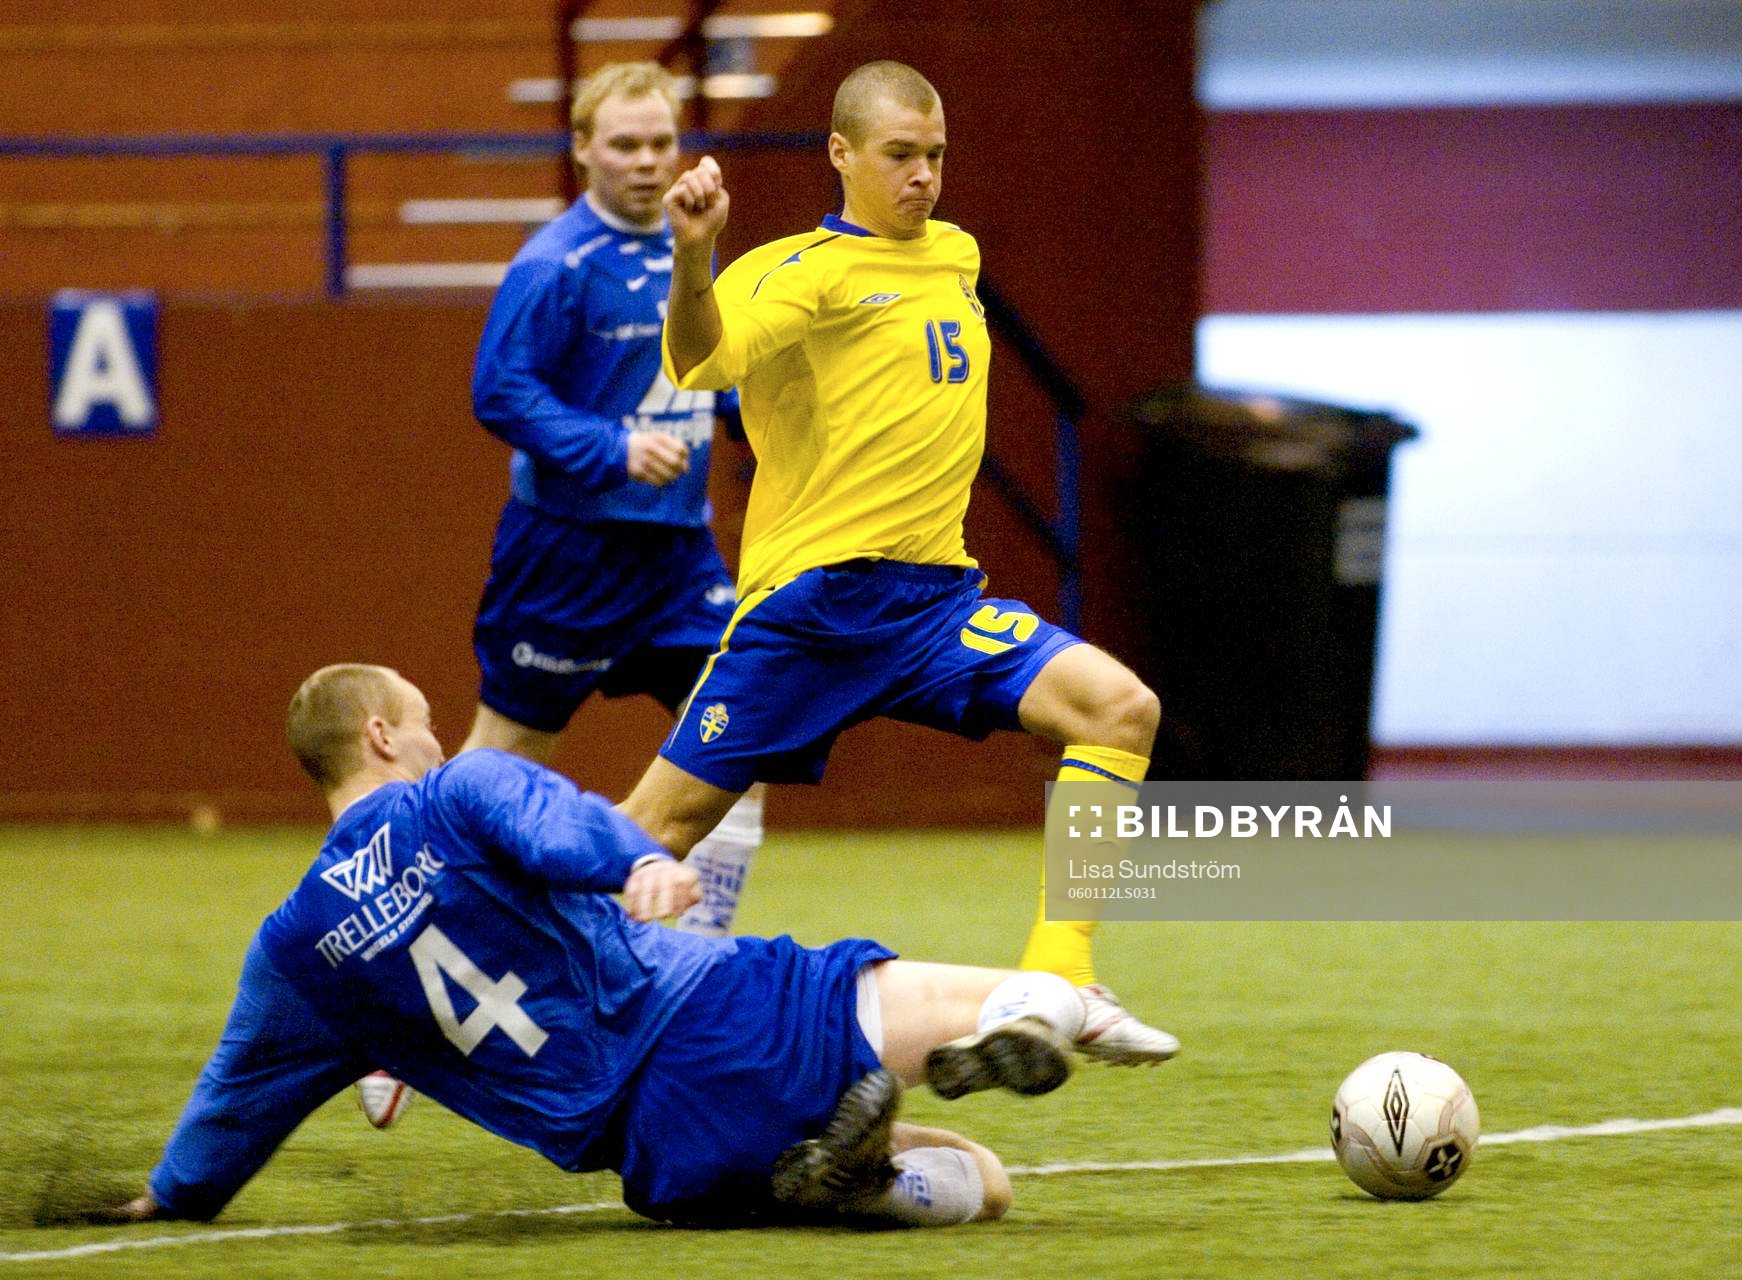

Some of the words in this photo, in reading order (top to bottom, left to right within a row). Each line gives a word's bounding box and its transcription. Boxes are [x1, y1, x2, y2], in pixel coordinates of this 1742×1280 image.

[53, 299, 153, 428] A
[925, 319, 970, 384] 15
[960, 604, 1040, 656] 15
[408, 922, 550, 1059] 4
